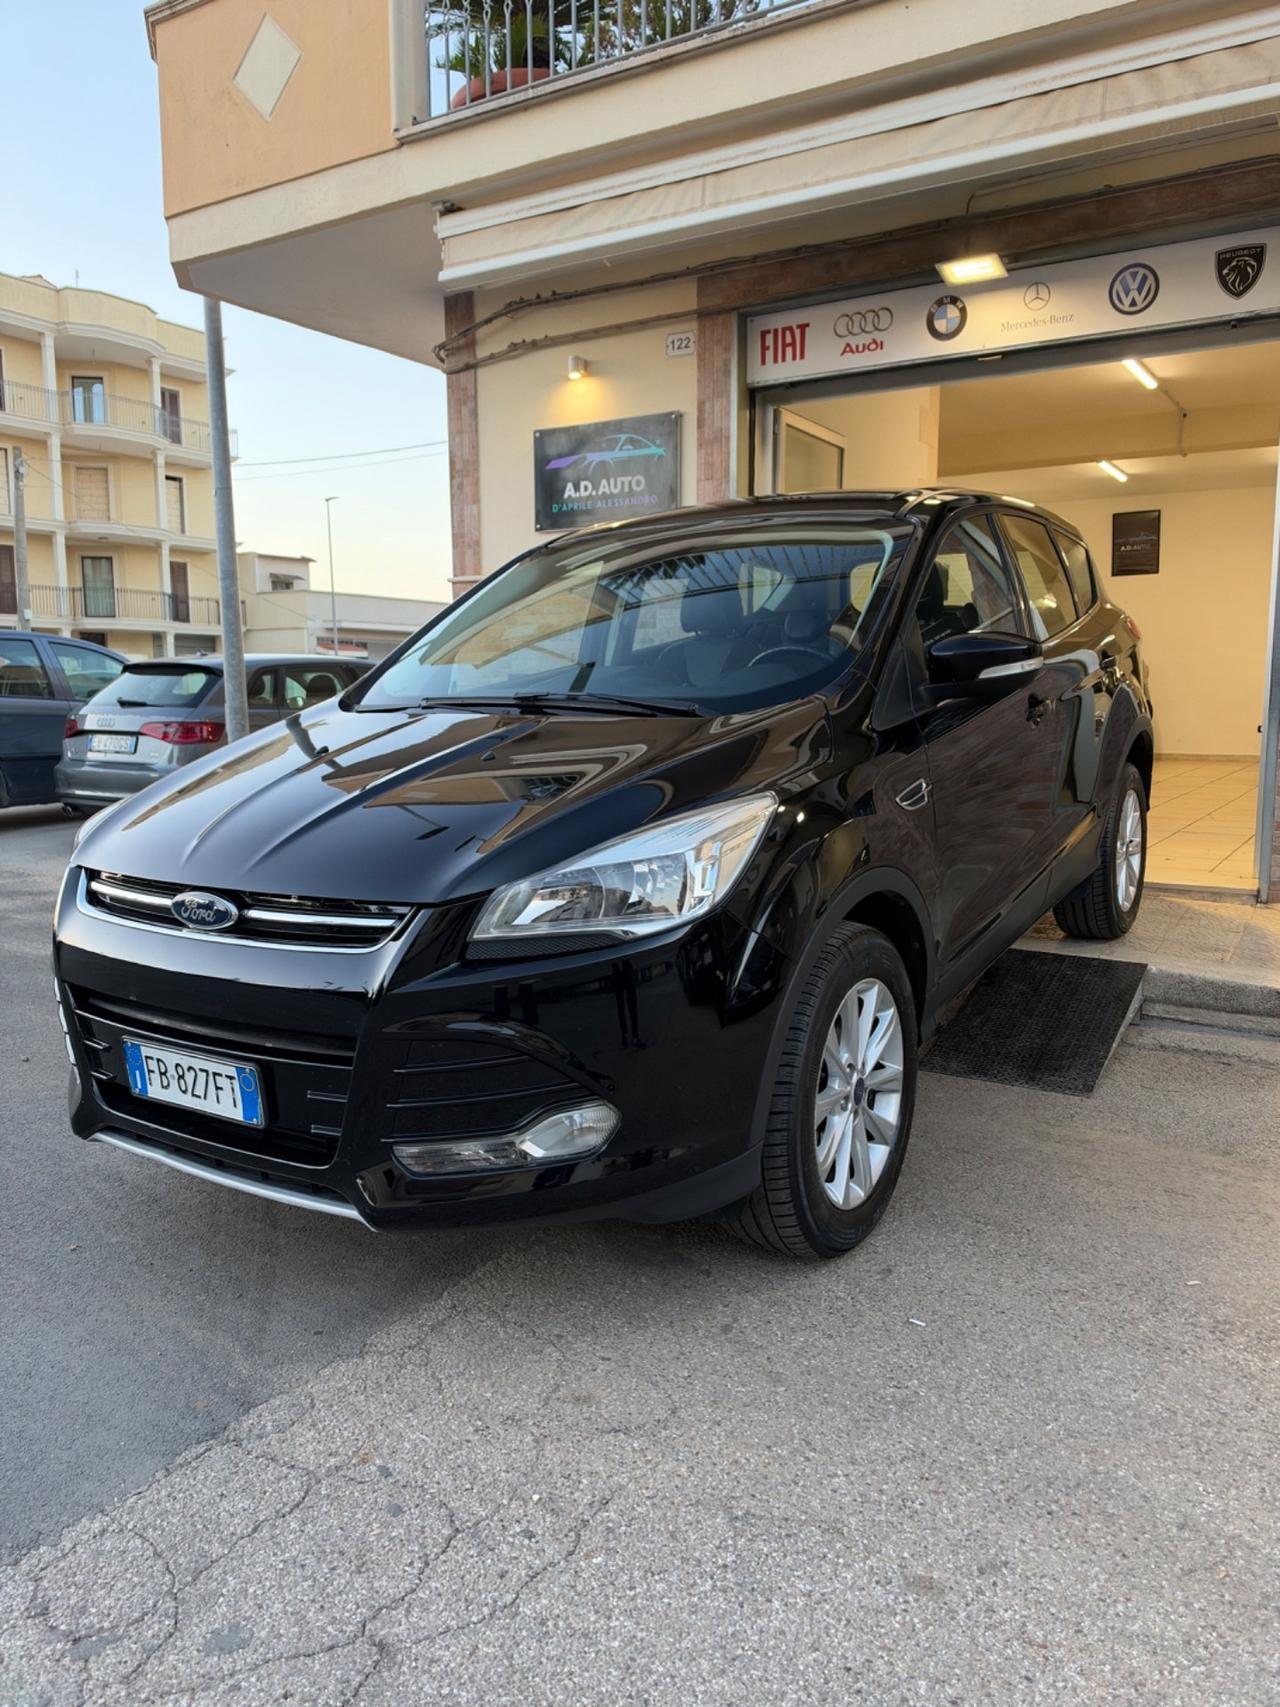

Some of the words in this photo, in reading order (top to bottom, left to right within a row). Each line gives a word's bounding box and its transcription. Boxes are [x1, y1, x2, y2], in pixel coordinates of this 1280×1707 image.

[1219, 247, 1262, 260] PEUGEOT
[930, 296, 965, 313] BMW
[1000, 313, 1074, 333] Mercedes-Benz
[670, 336, 691, 352] 122
[760, 322, 810, 367] FIAT
[840, 338, 884, 356] Audi
[552, 501, 593, 513] D'APRILE
[595, 495, 658, 509] ALESSANDRO
[181, 897, 217, 922] Ford
